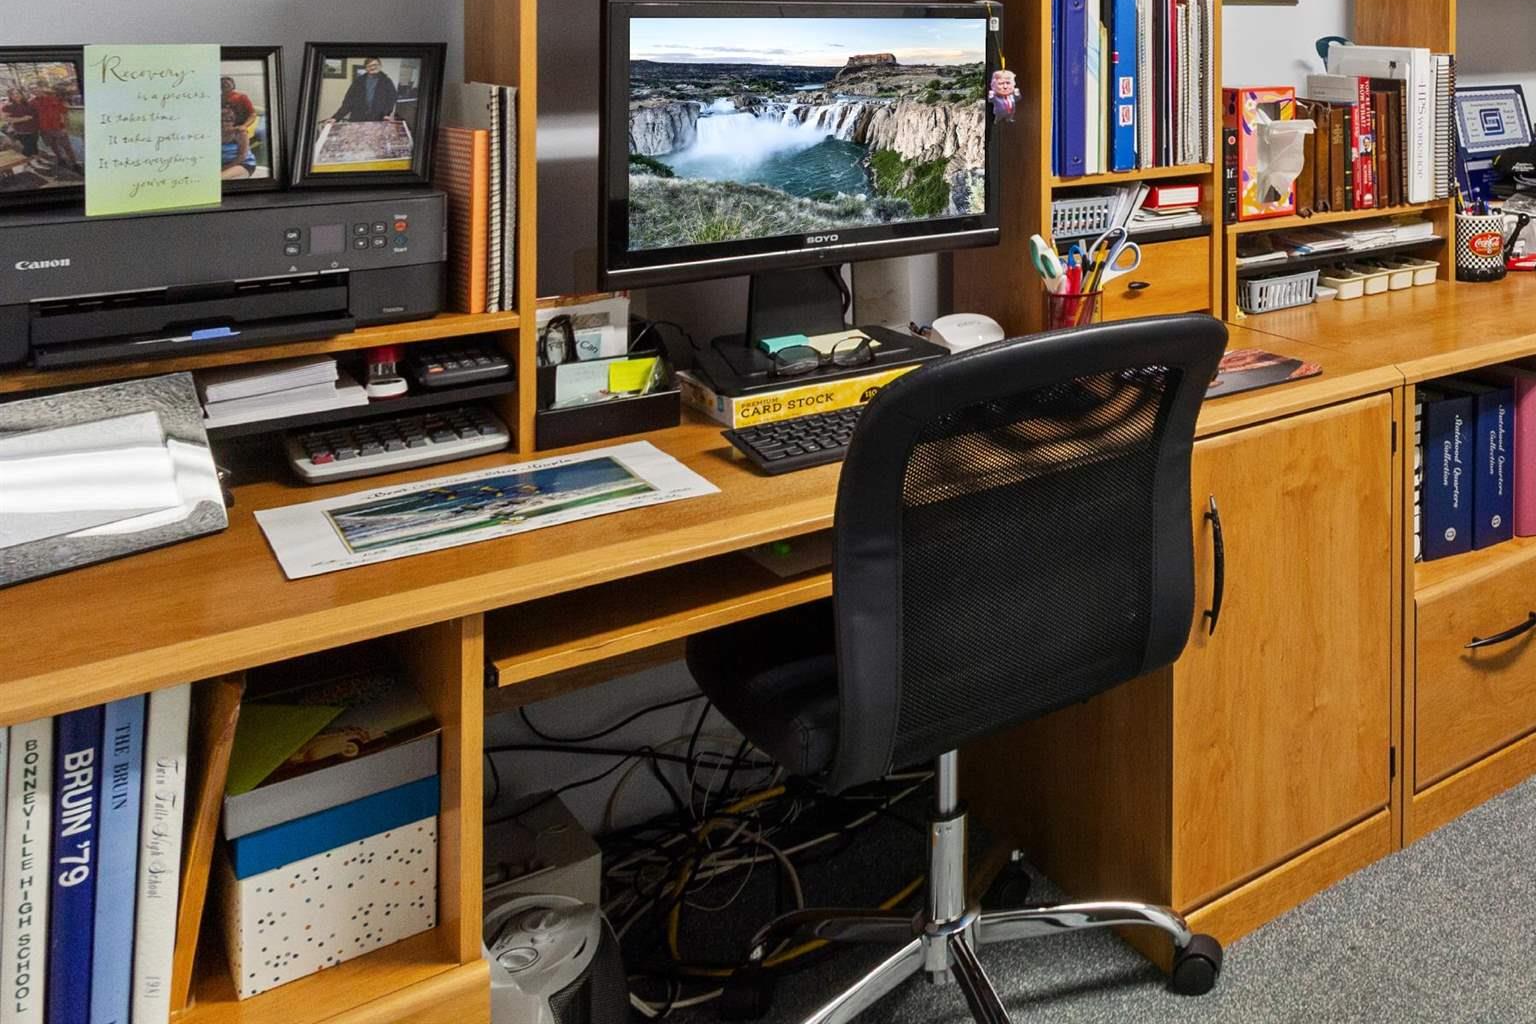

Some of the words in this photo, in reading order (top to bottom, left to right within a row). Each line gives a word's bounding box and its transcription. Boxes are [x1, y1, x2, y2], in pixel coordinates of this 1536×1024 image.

[101, 113, 111, 124] It
[116, 113, 146, 123] takes
[109, 135, 118, 145] It
[123, 133, 153, 144] takes
[98, 158, 108, 169] It
[114, 157, 142, 167] takes
[806, 234, 839, 244] SOYO
[15, 258, 71, 270] Canon
[741, 396, 779, 408] PREMIUM
[741, 402, 782, 419] CARD
[787, 392, 835, 410] STOCK
[1454, 414, 1463, 464] Statehood
[1489, 430, 1497, 475] Collection
[1443, 440, 1452, 486] Collection
[1453, 467, 1462, 509] Quarters
[113, 723, 131, 759] THE
[19, 739, 40, 870] BONNEVILLE
[60, 747, 95, 838] BRUIN
[111, 762, 130, 811] BRUIN
[58, 840, 91, 888] '79
[17, 875, 33, 928] HIGH
[15, 932, 31, 1014] SCHOOL
